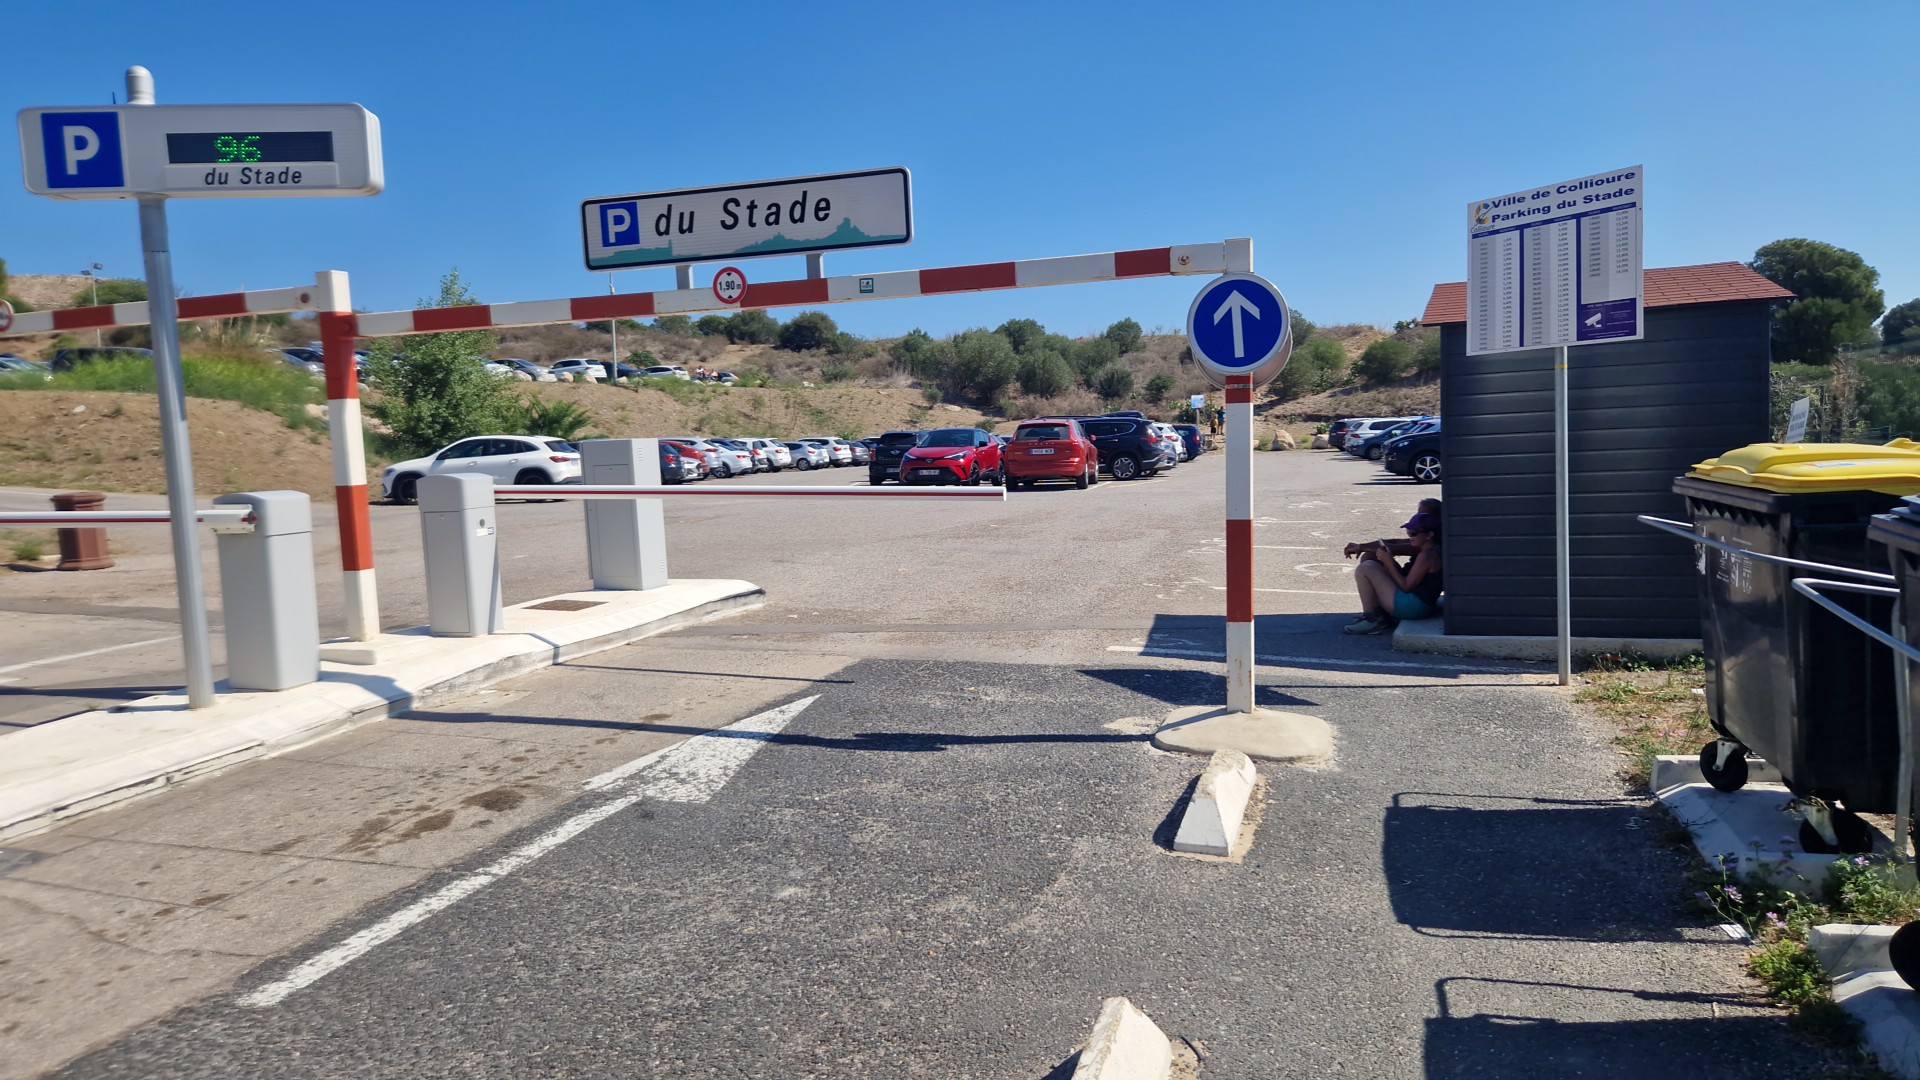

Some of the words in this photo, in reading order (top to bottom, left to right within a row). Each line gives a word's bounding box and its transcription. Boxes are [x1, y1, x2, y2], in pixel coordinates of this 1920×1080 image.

[63, 125, 100, 175] P
[215, 135, 262, 163] 96
[204, 168, 230, 186] du
[240, 166, 303, 185] Stade
[1491, 196, 1526, 209] Ville
[1531, 190, 1551, 200] de
[1556, 171, 1636, 195] Collioure
[607, 207, 632, 244] P
[655, 203, 695, 237] du
[720, 190, 832, 231] Stade
[1491, 204, 1551, 223] Parking
[1556, 198, 1577, 210] du
[1582, 187, 1635, 204] Stade
[718, 280, 736, 292] 1,90
